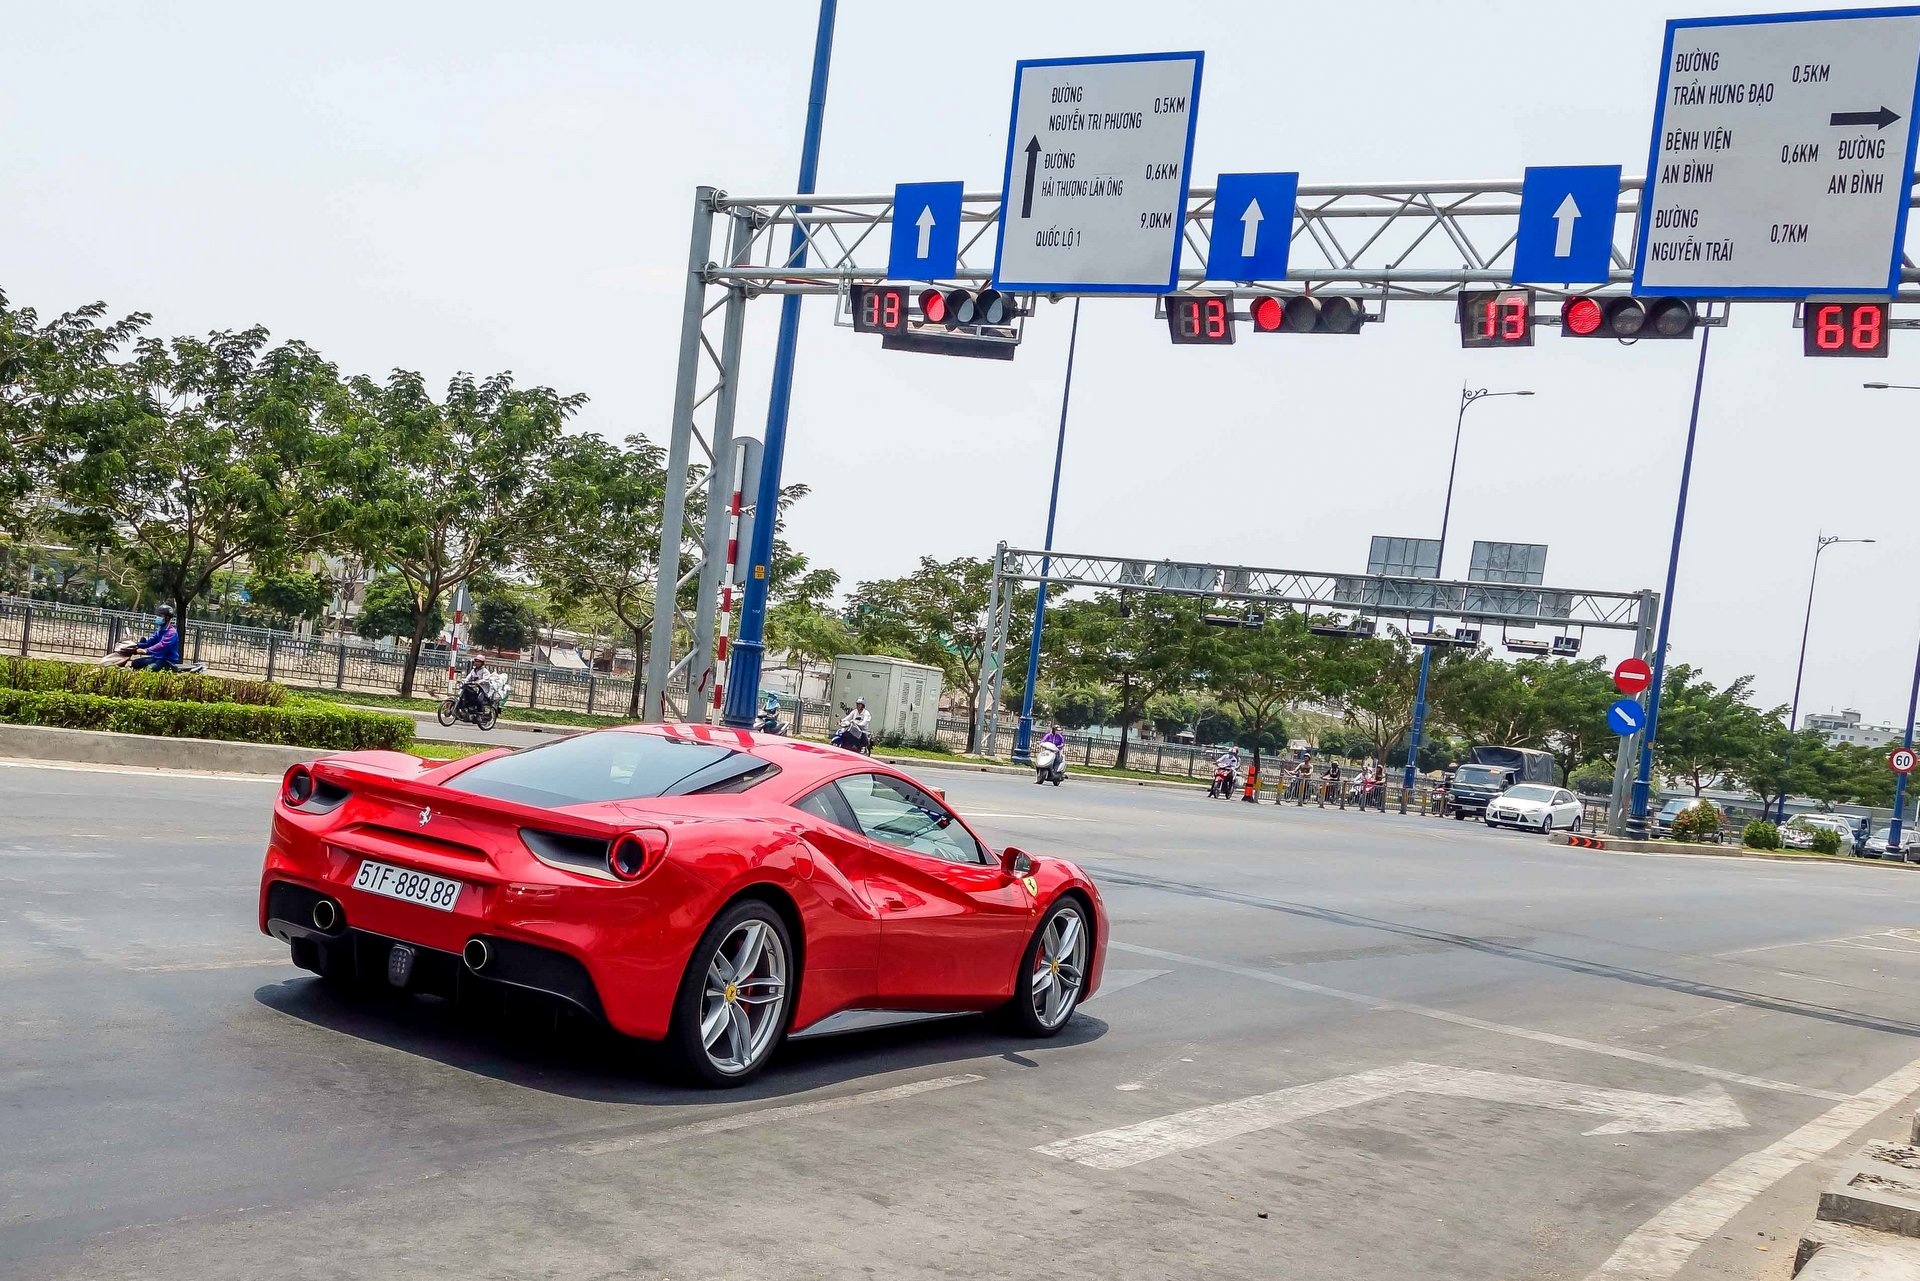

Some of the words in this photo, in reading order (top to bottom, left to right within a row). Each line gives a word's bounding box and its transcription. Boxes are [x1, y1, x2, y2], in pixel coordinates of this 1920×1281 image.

[1676, 48, 1720, 72] ĐƯỜNG
[1792, 64, 1830, 84] 0,5KM
[1051, 82, 1083, 103] ĐƯỜNG
[1674, 79, 1706, 105] TRẦN
[1709, 83, 1744, 104] HƯNG
[1748, 83, 1774, 106] ĐẠO
[1154, 97, 1185, 114] 0,5KM
[1048, 108, 1085, 131] NGUYỄN
[1088, 113, 1102, 131] TRI
[1104, 112, 1143, 130] PHƯƠNG
[1666, 128, 1699, 154] BỆNH
[1703, 126, 1732, 153] VIỆN
[1838, 135, 1886, 160] ĐƯỜNG
[1044, 149, 1076, 169] ĐƯỜNG
[1781, 144, 1819, 165] 0,6KM
[1146, 163, 1178, 181] 0,6KM
[1661, 164, 1680, 184] AN
[1683, 159, 1714, 184] BÌNH
[1827, 174, 1847, 194] AN
[1851, 169, 1884, 194] BÌNH
[1041, 177, 1054, 197] HẢI
[1056, 180, 1088, 200] THƯỢNG
[1106, 177, 1124, 197] ÔNG
[1140, 212, 1172, 230] 9,0KM
[1655, 205, 1699, 229] ĐƯỜNG
[1035, 224, 1060, 247] QUỐC
[1061, 227, 1073, 250] LỘ
[1076, 230, 1081, 247] 1
[1770, 224, 1809, 245] 0,7KM
[1651, 235, 1701, 262] NGUYỄN
[1705, 238, 1734, 262] TRÃI
[1191, 300, 1225, 337] 13
[1485, 296, 1526, 340] 13
[1816, 305, 1881, 349] 68
[1895, 755, 1911, 767] 60
[358, 863, 456, 906] 51F-889.88
